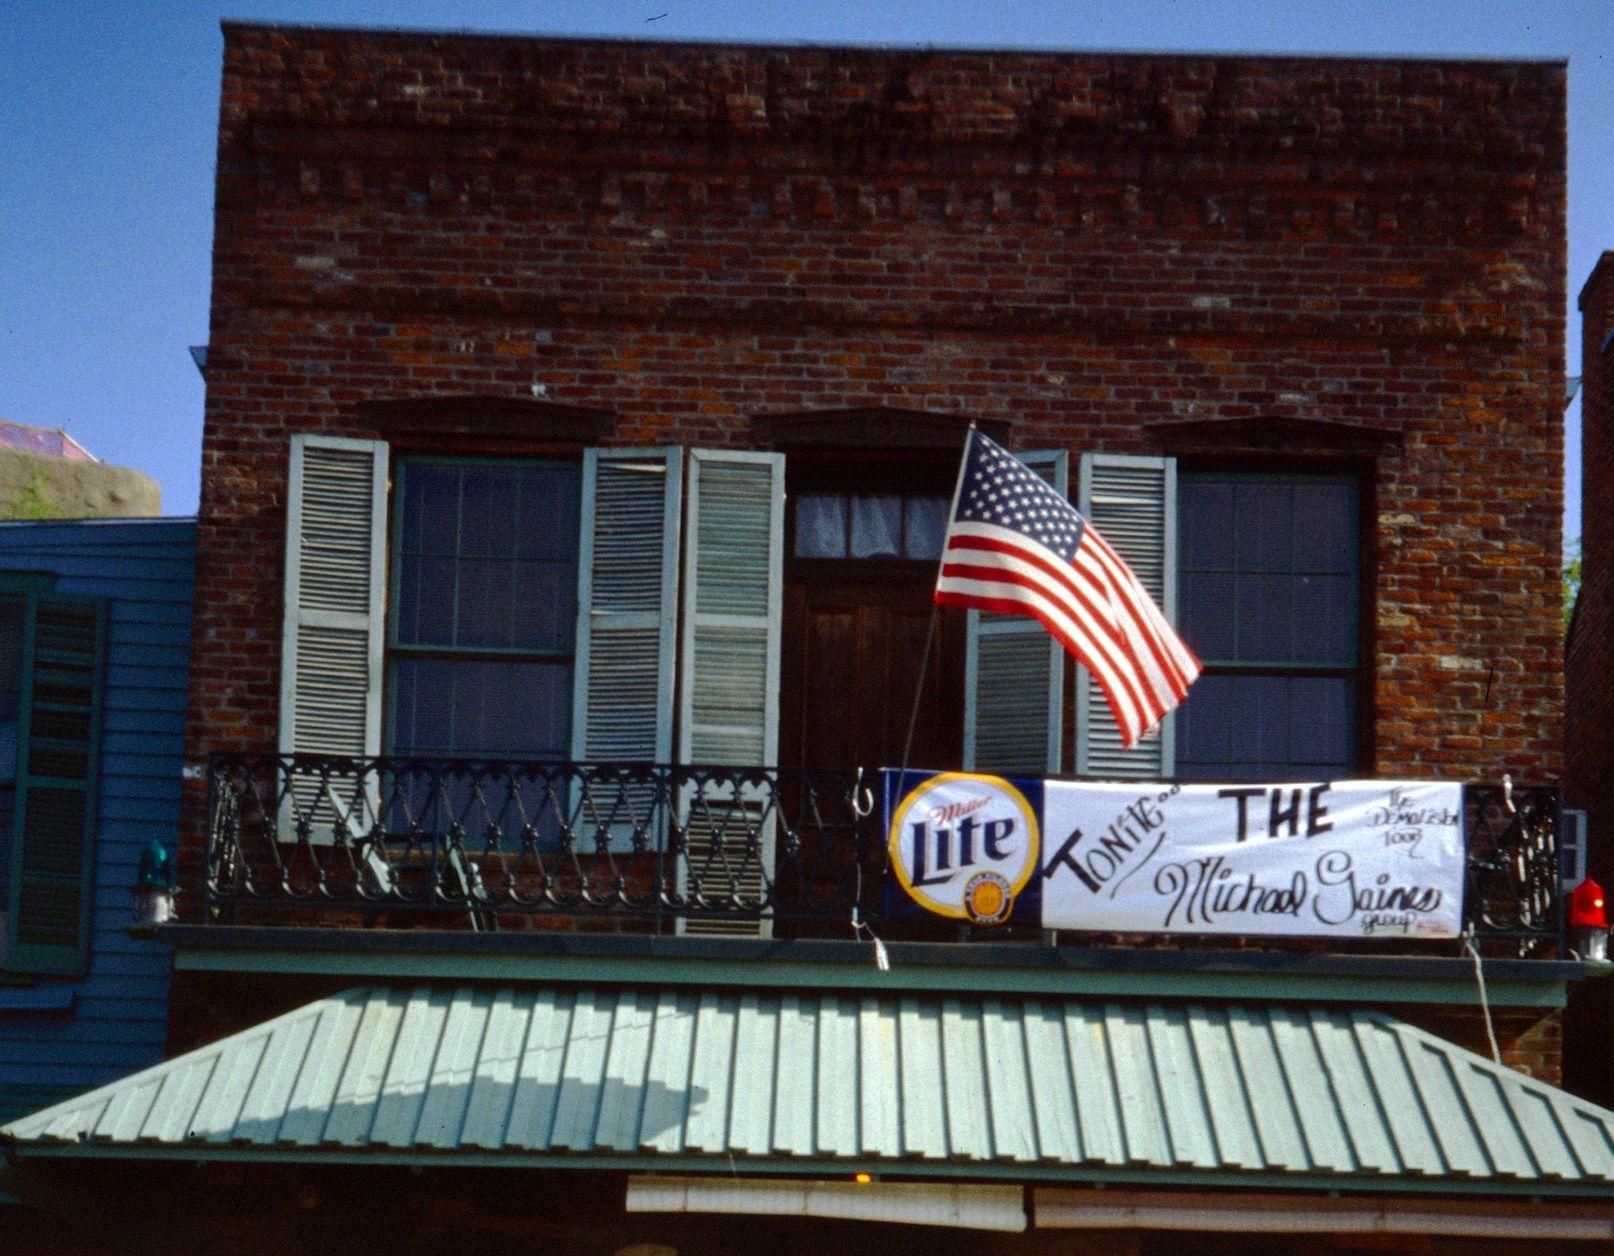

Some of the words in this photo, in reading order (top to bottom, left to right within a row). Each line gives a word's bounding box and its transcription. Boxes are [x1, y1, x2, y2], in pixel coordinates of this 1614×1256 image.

[928, 795, 993, 826] Miller
[1218, 782, 1334, 842] THE
[910, 815, 1020, 887] Lite
[1154, 856, 1308, 928] Michael
[1313, 850, 1443, 926] Gaines
